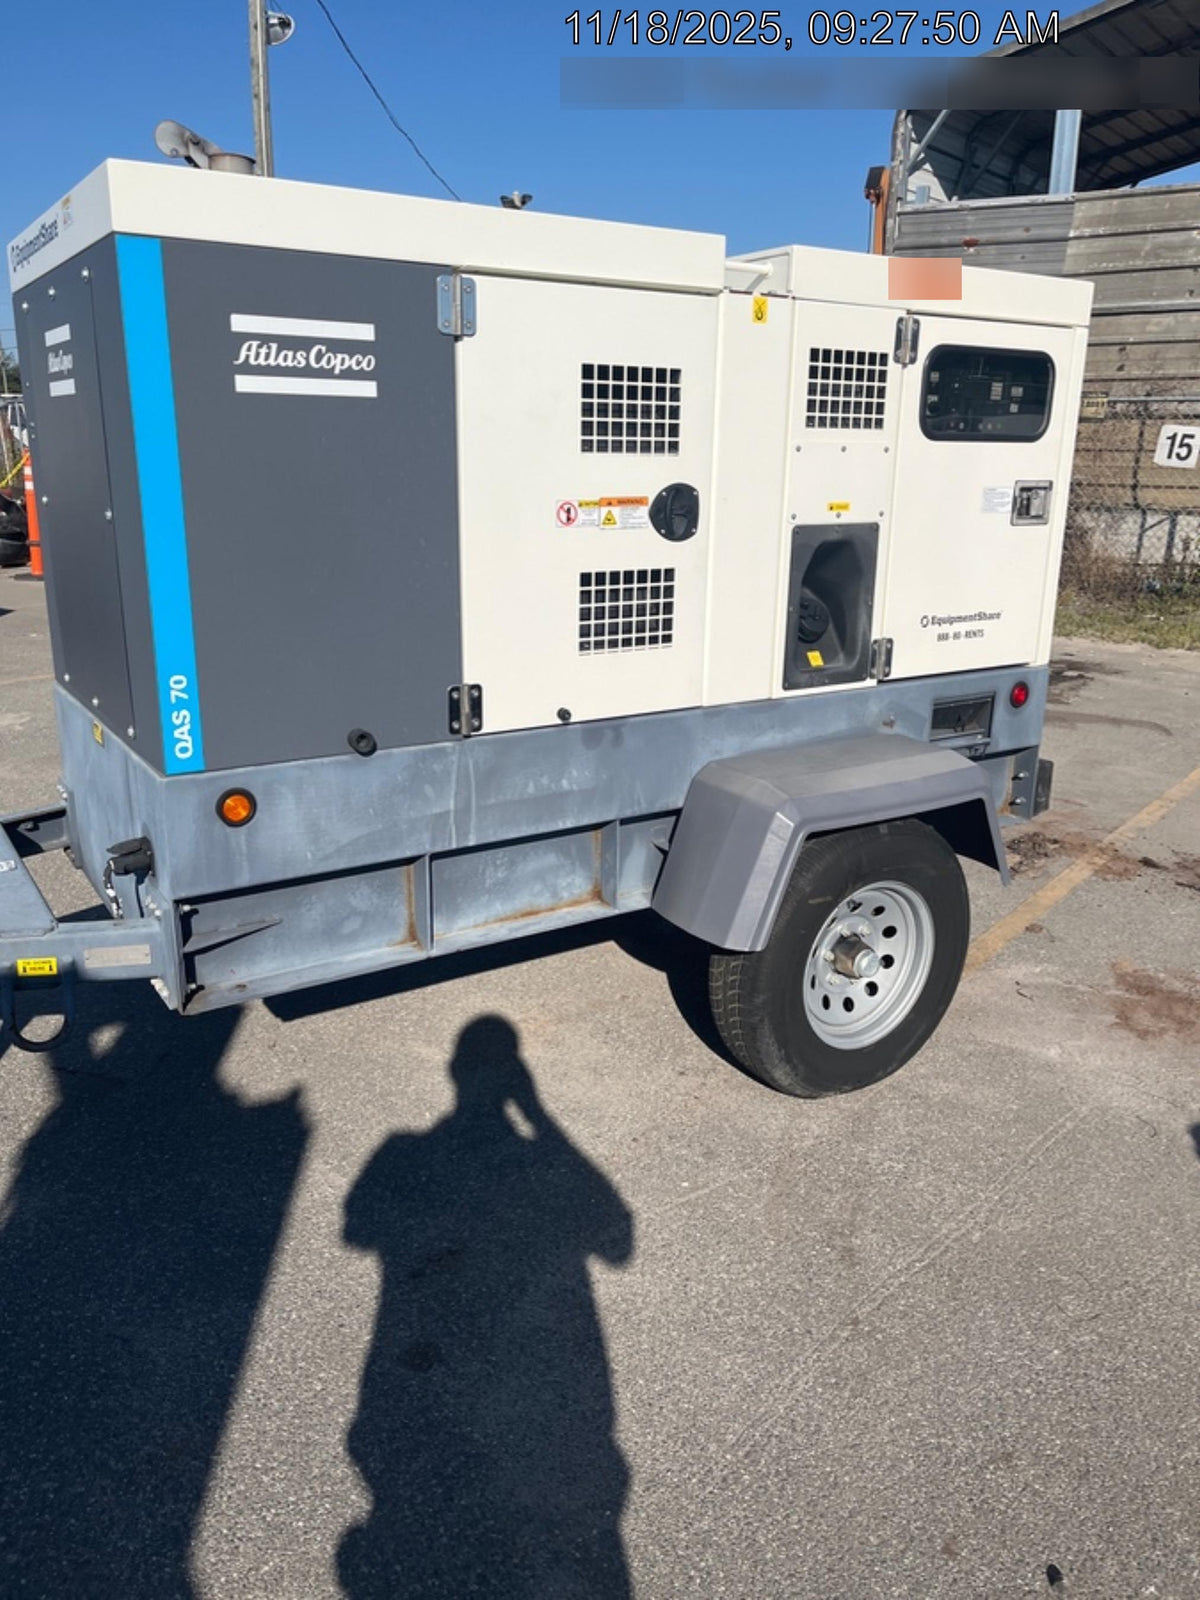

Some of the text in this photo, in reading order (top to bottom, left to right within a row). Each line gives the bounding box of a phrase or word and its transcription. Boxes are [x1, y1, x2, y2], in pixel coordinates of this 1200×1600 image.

[1166, 432, 1195, 462] 15
[169, 674, 193, 760] QAS 70
